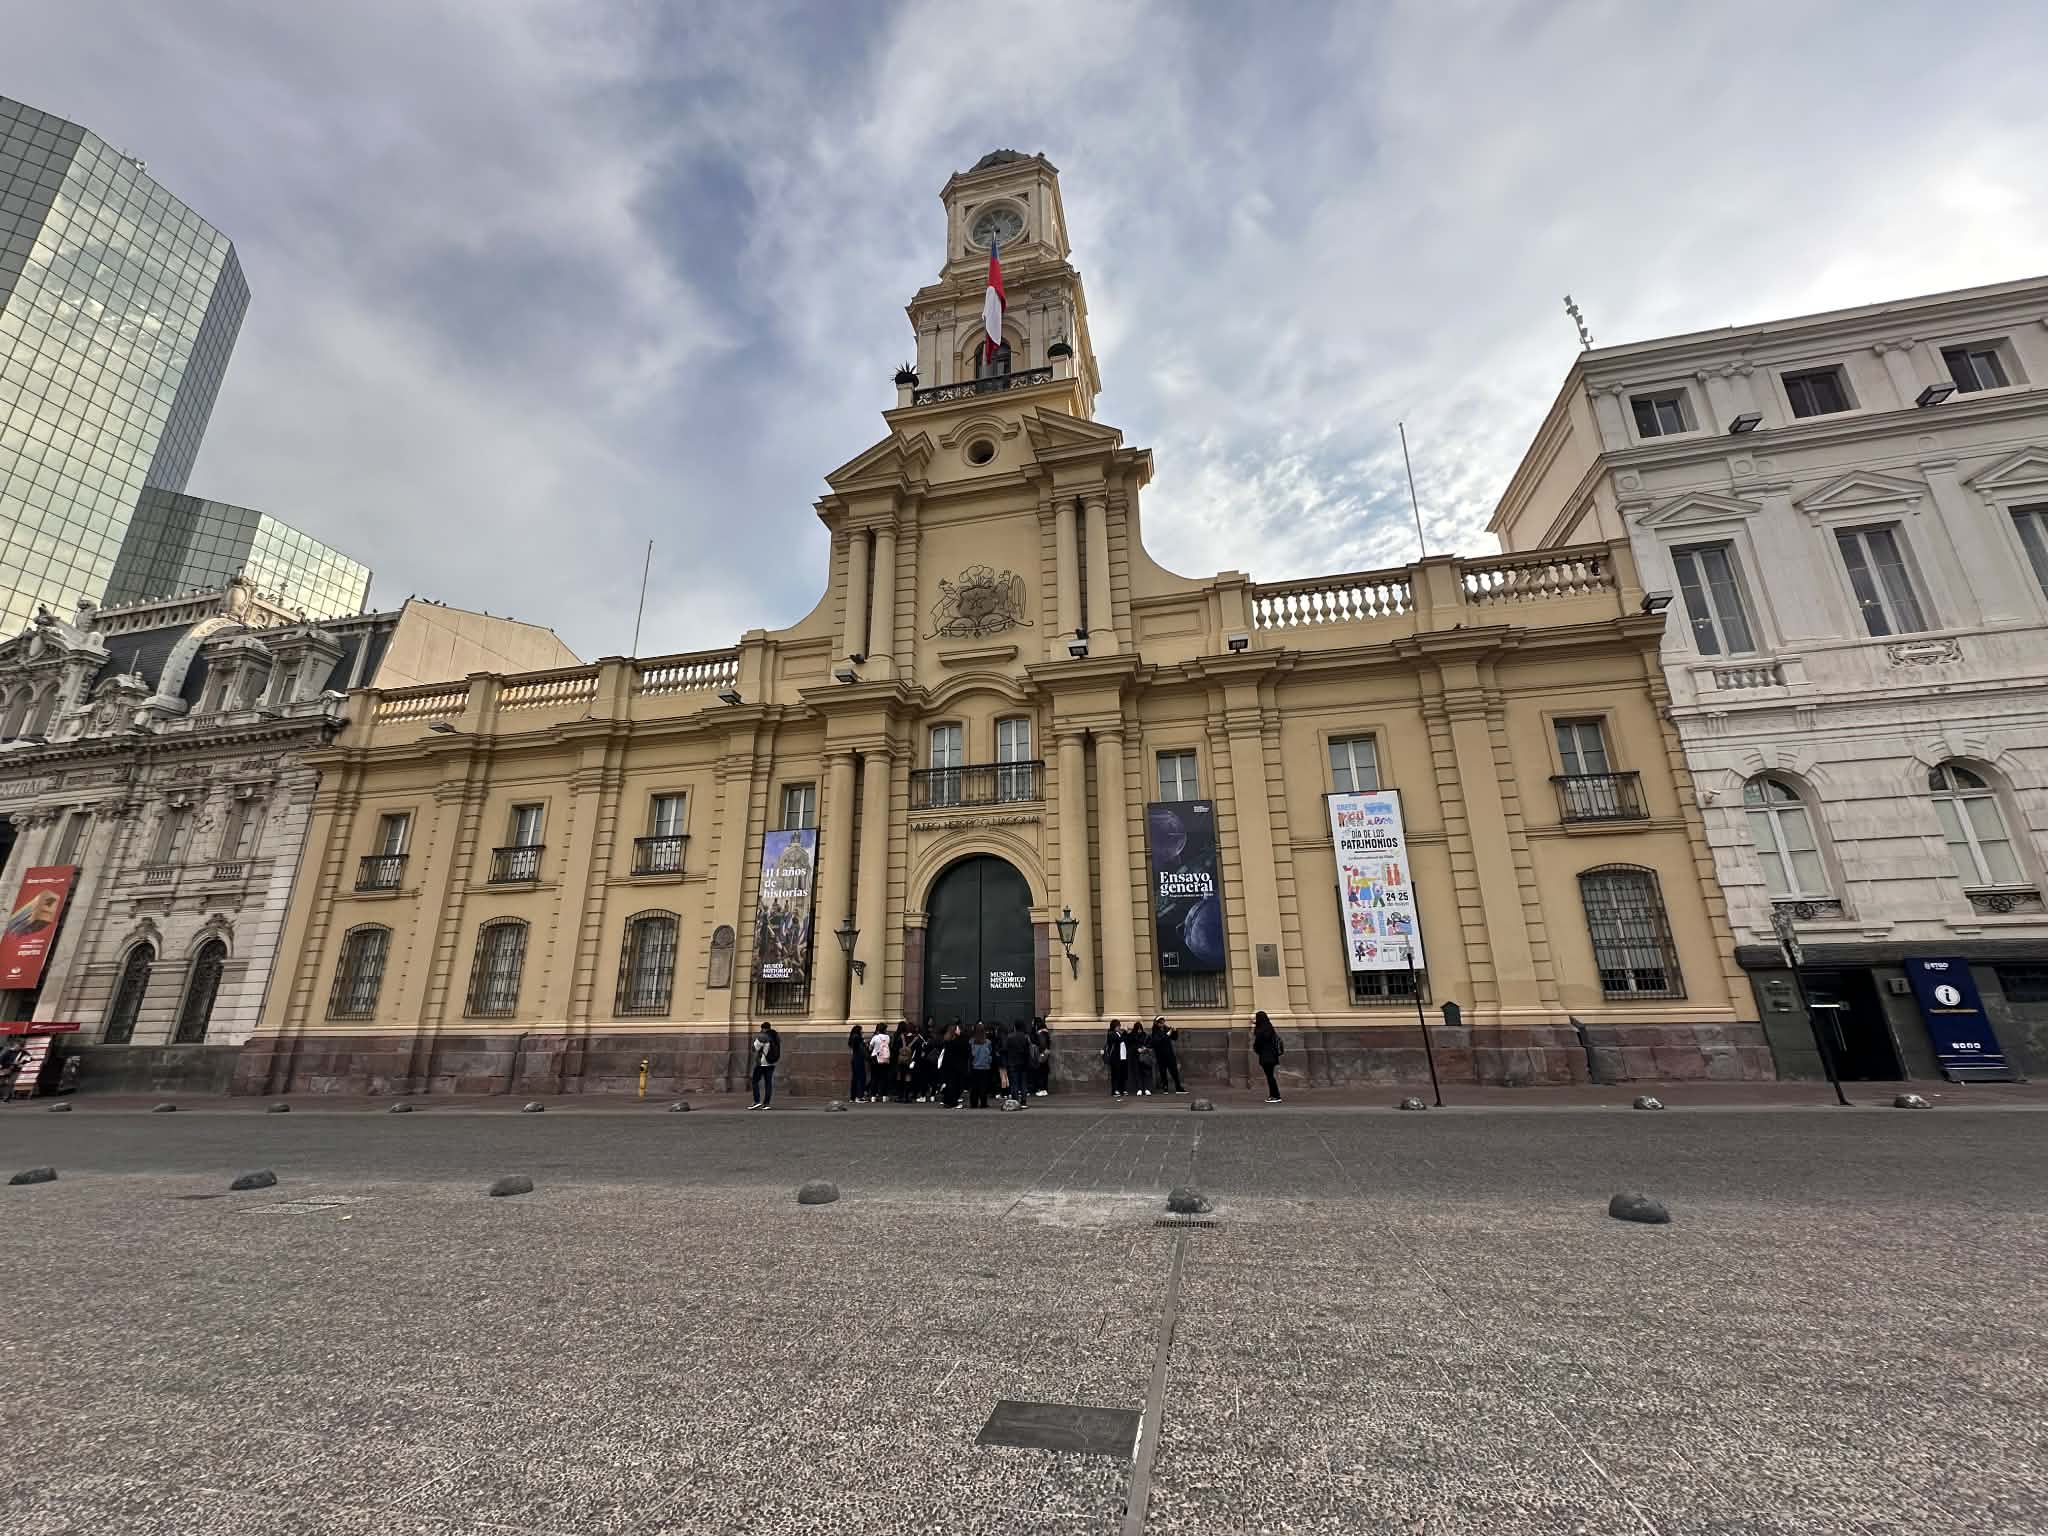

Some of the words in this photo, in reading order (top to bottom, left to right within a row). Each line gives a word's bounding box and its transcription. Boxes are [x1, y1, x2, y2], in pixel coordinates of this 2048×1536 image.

[1363, 829, 1371, 838] DE
[1373, 828, 1385, 838] LOS
[1341, 837, 1399, 850] PATRIMONIOS
[782, 866, 807, 877] años
[764, 878, 777, 888] de
[1160, 871, 1210, 885] Ensayo
[763, 887, 809, 898] historias
[1160, 880, 1213, 897] general
[1385, 892, 1396, 902] 24
[1398, 891, 1409, 901] 25
